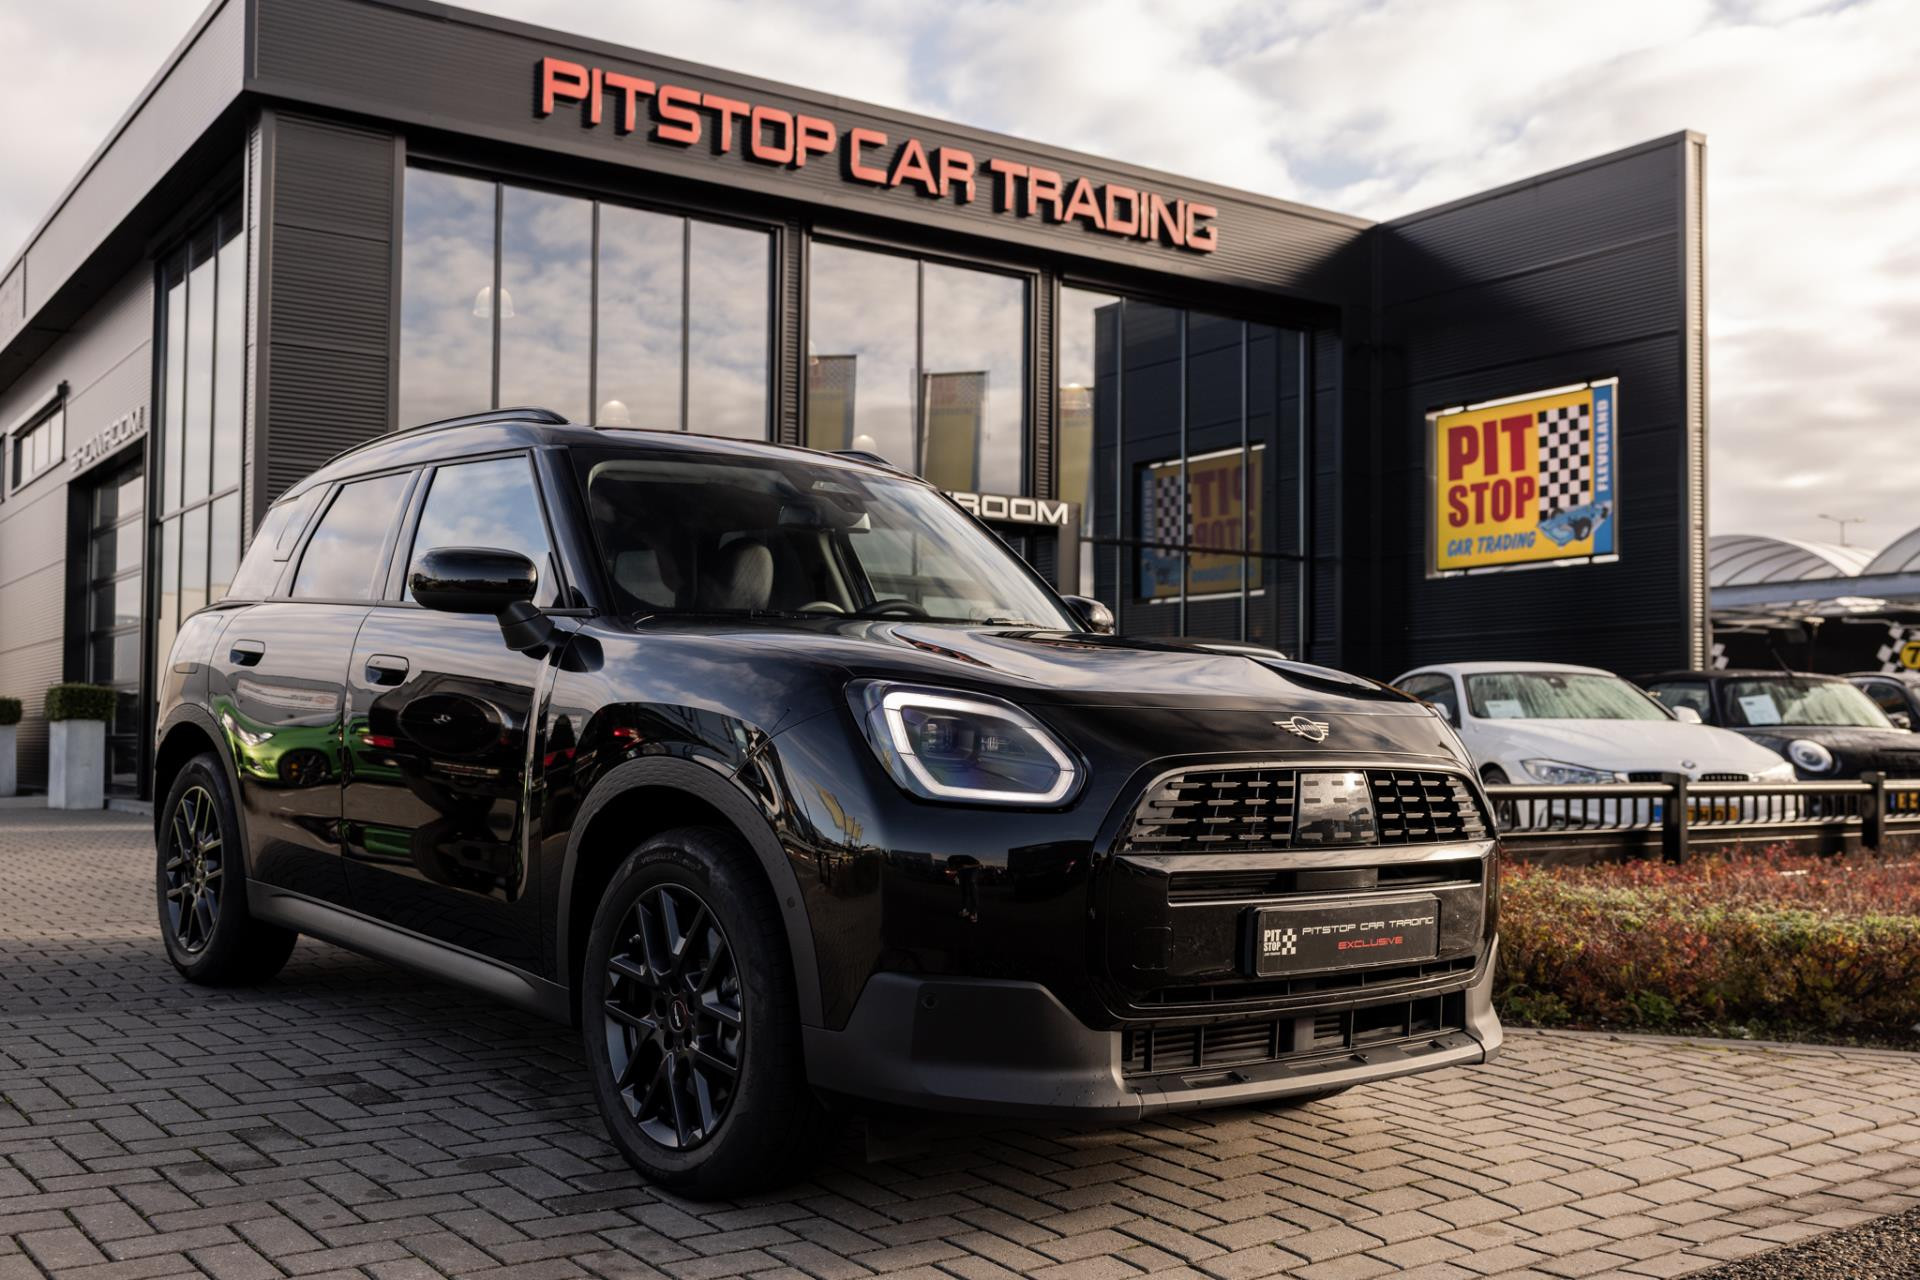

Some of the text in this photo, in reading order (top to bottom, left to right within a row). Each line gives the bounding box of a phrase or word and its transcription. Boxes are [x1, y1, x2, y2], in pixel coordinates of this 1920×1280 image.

[541, 56, 1218, 253] PITSTOP CAR TRADING
[1447, 413, 1534, 482] PIT
[1447, 475, 1536, 528] STOP
[1447, 531, 1537, 557] CAR TRADING
[1263, 929, 1282, 942] PIT
[1302, 915, 1435, 936] PITSTOP CAR TRADING
[1263, 941, 1282, 952] STOP
[1337, 936, 1404, 950] EXCLUSIVE
